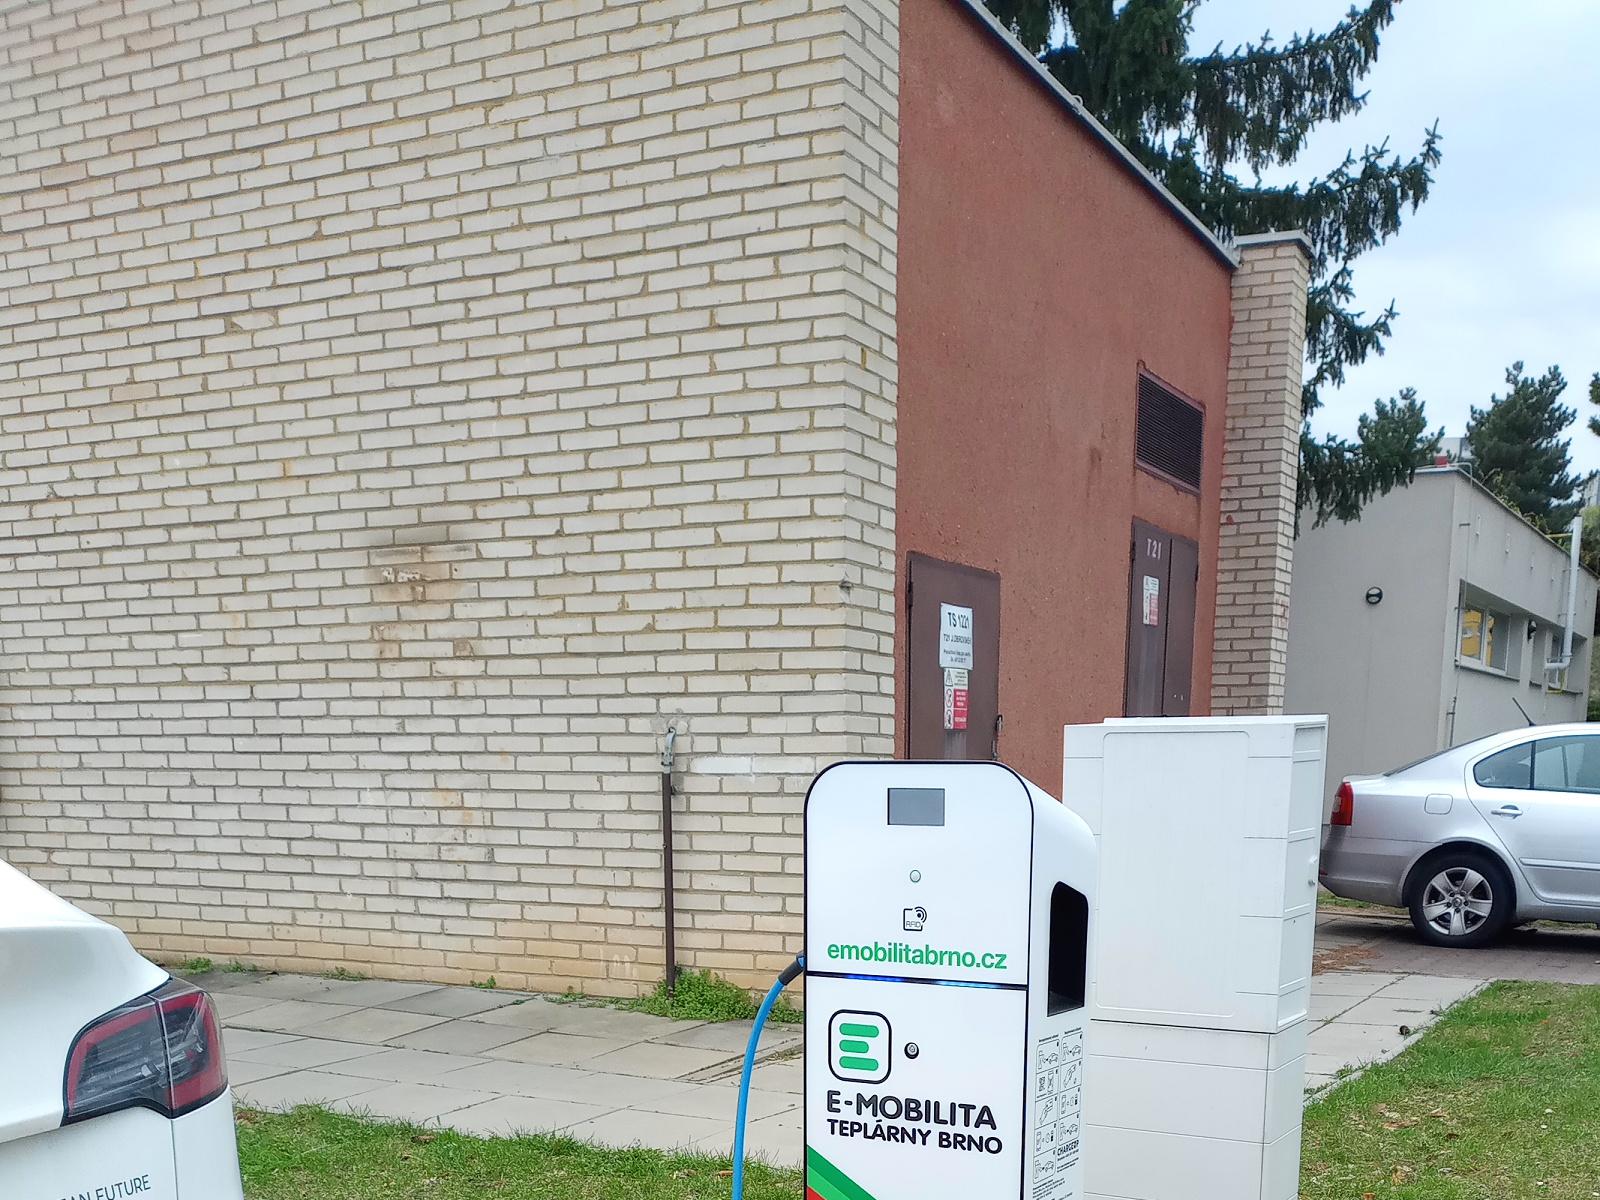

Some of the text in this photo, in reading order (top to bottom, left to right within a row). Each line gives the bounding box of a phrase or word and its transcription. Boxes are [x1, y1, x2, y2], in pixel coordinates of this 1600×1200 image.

[1147, 538, 1162, 560] T21
[948, 612, 957, 627] TS
[827, 941, 1008, 969] emobilitabrno.cz
[826, 1090, 997, 1130] E-MOBILITA
[827, 1119, 1003, 1155] TEPLÁRNY BRNO
